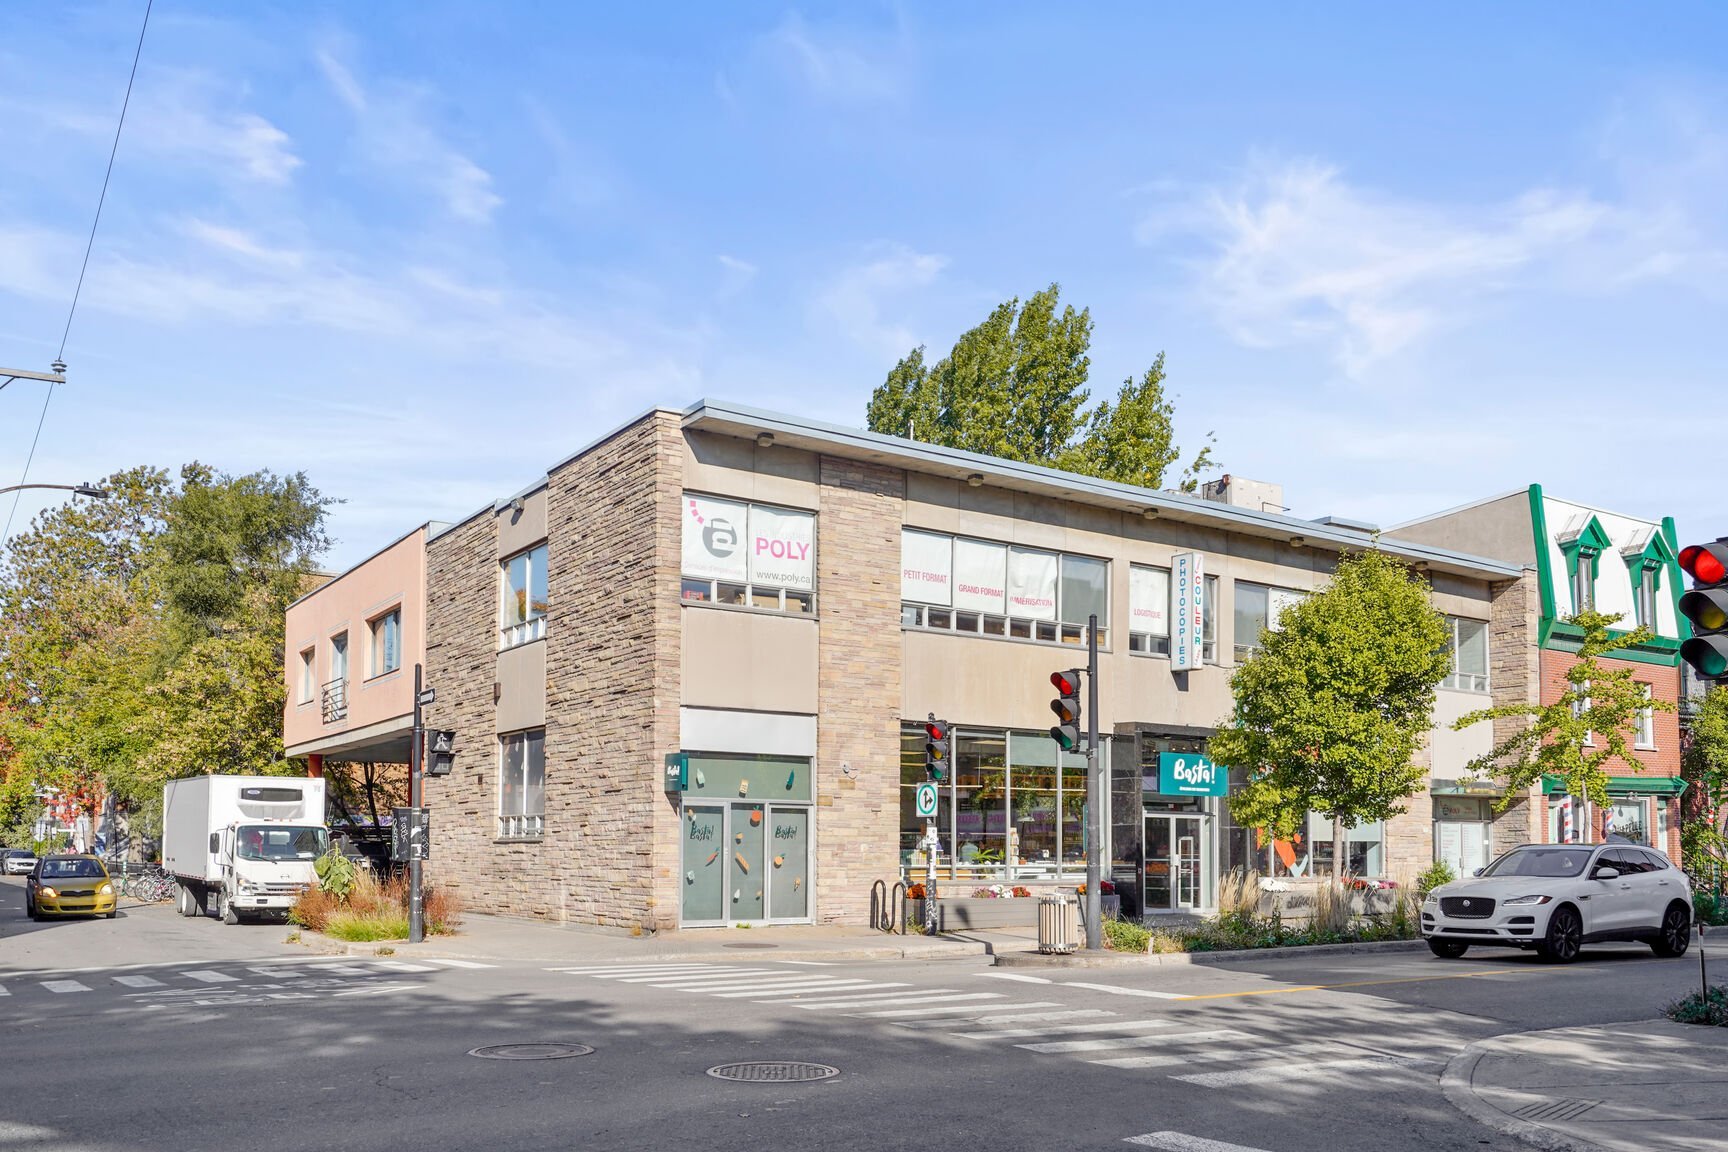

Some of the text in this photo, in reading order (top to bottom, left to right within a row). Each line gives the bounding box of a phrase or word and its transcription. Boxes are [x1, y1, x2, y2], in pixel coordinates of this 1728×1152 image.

[756, 537, 810, 561] POLY
[756, 570, 811, 585] www.poly.ca
[903, 569, 947, 584] PETIT FORMAT
[958, 584, 1004, 598] GRAND FORMAT
[1173, 758, 1216, 785] Basta!
